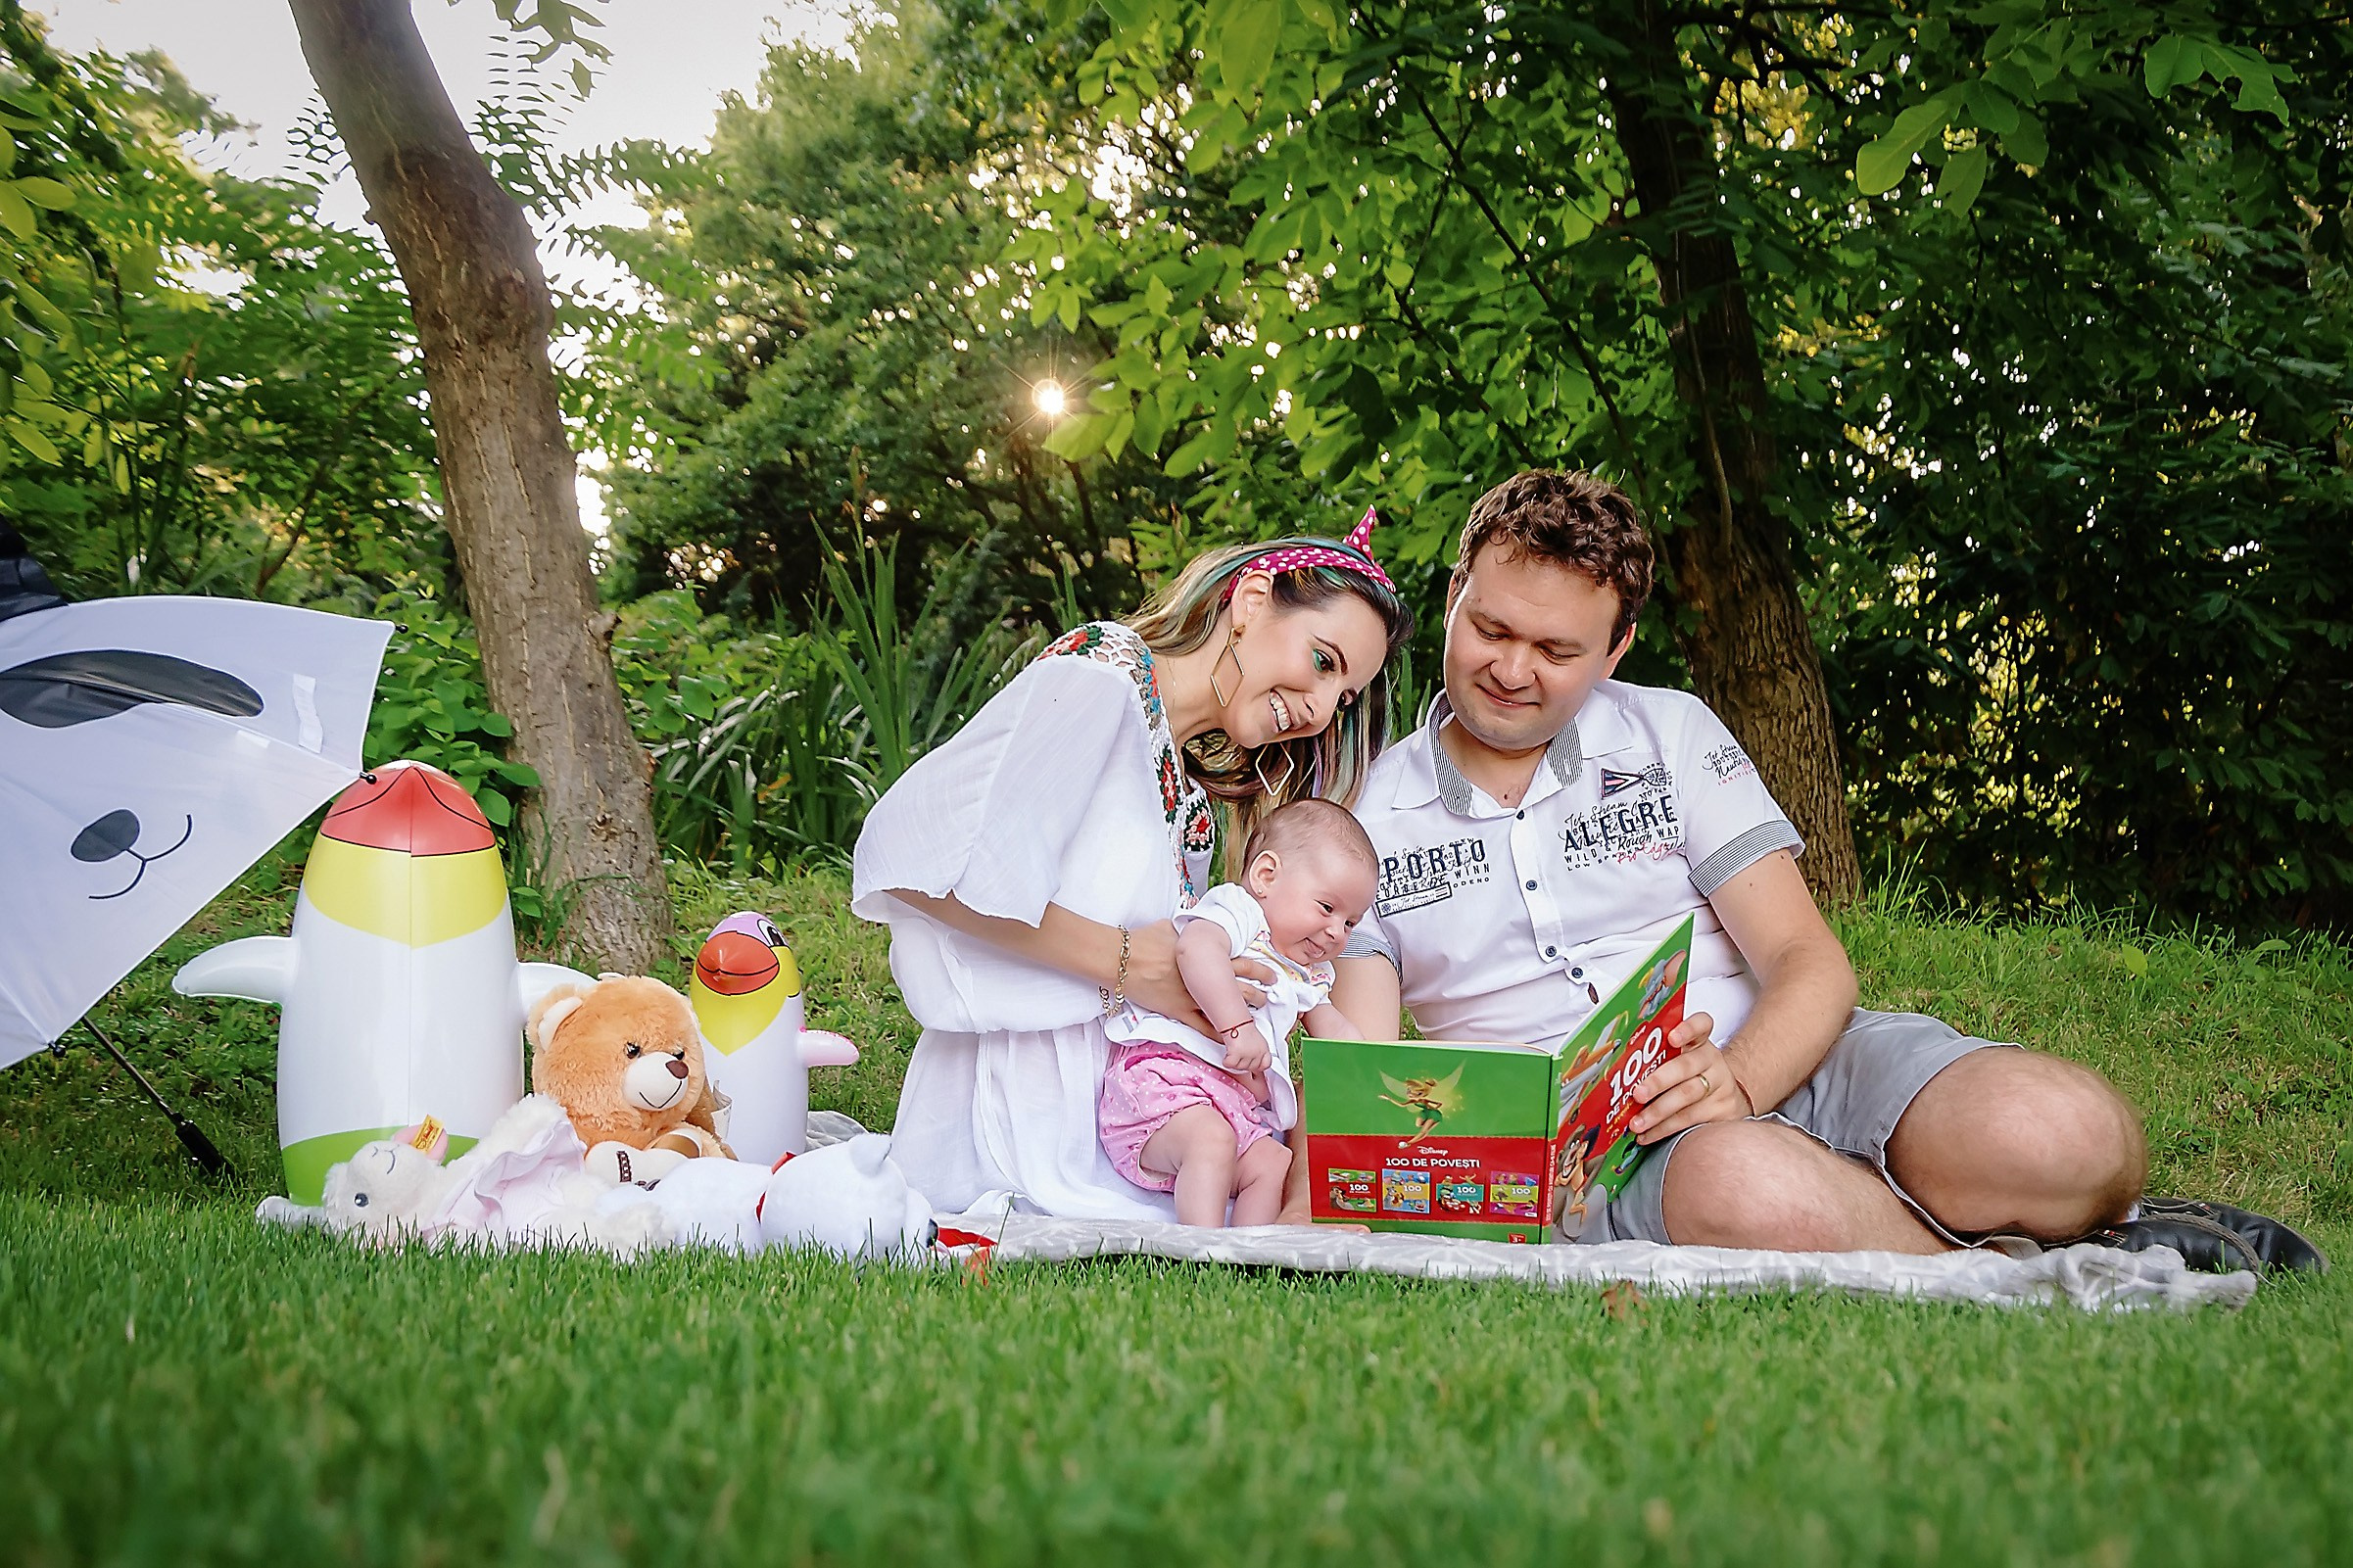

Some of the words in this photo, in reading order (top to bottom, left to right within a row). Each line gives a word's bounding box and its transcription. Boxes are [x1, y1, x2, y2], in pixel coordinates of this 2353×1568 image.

[1564, 794, 1678, 852] ALEGRE
[1591, 802, 1627, 820] Stream
[1383, 839, 1485, 882] PORTO
[1564, 849, 1597, 863] WILD
[1617, 833, 1653, 851] Rough
[1609, 1026, 1662, 1107] 100
[1606, 1102, 1621, 1124] DE
[1385, 1158, 1411, 1166] 100
[1412, 1158, 1428, 1166] DE
[1417, 1146, 1449, 1156] Disney
